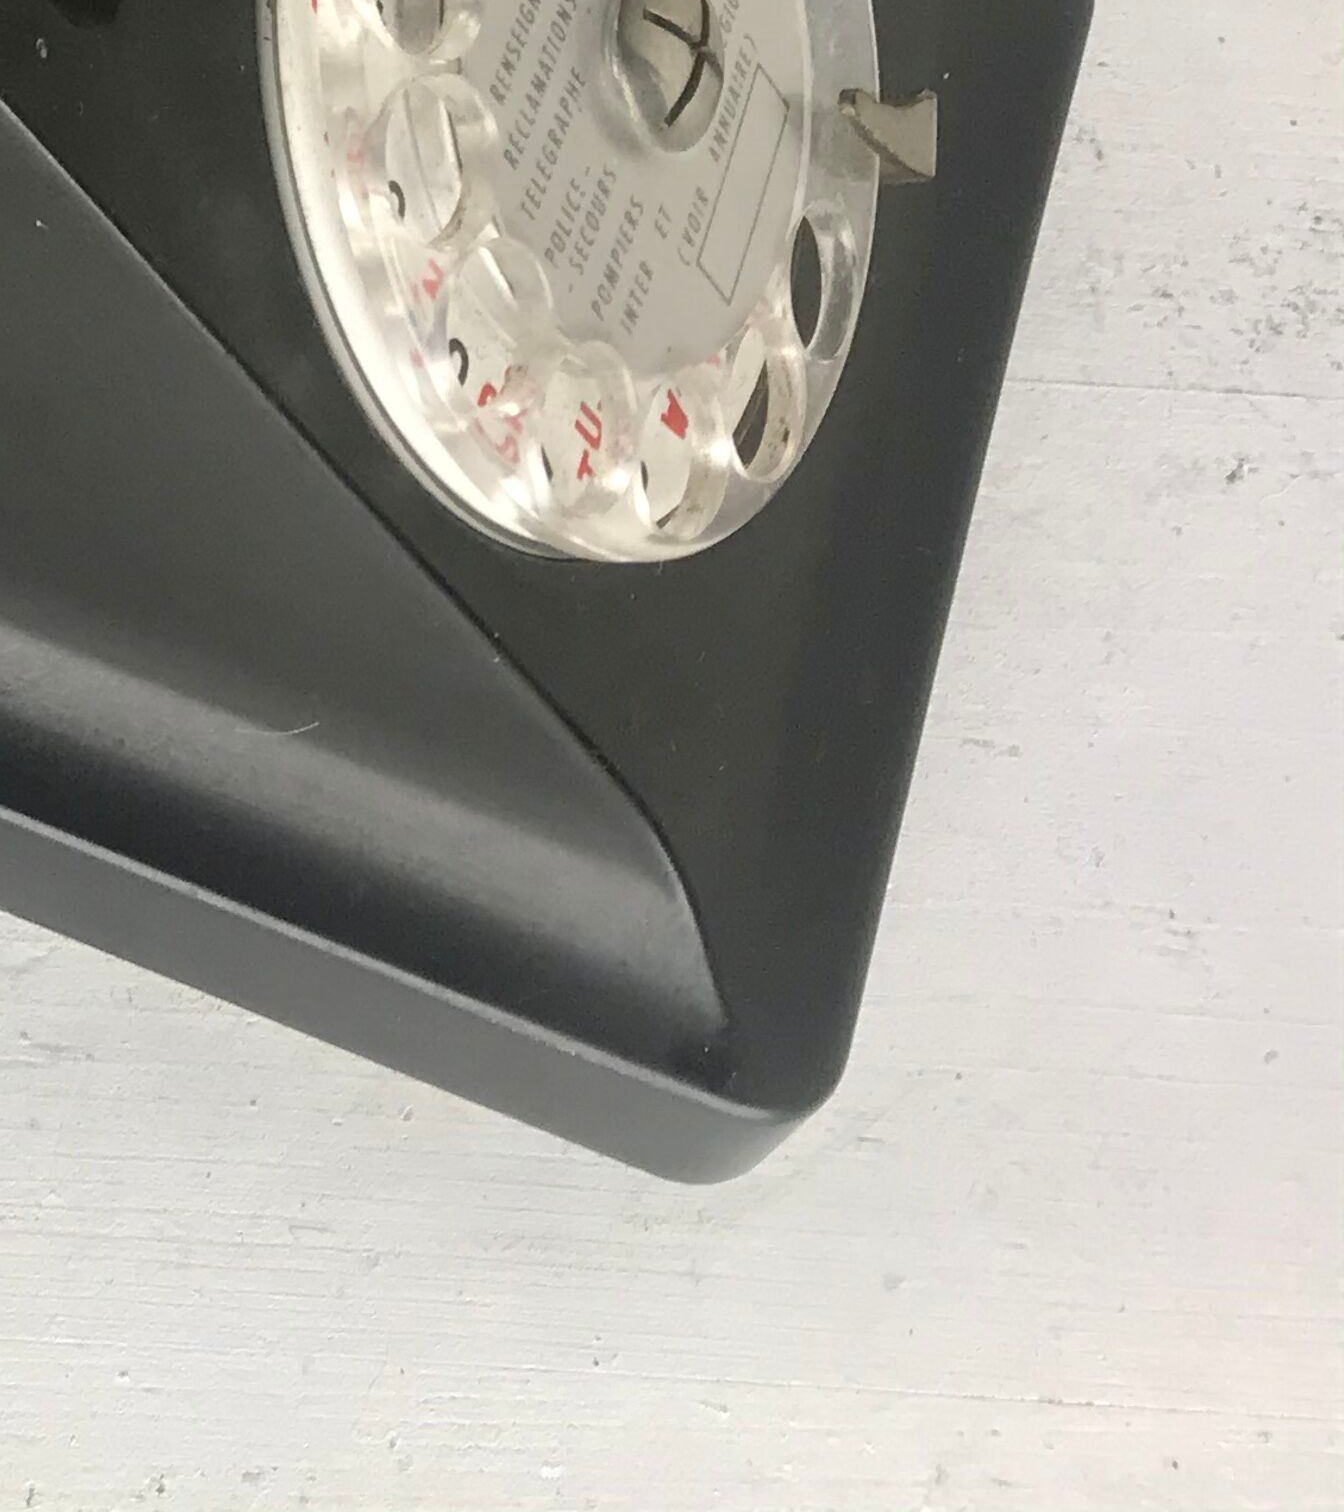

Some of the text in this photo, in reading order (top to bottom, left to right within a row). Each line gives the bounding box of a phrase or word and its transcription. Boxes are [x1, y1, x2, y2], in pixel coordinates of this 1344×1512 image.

[520, 66, 586, 221] TELEGRAPHE
[591, 193, 644, 322] POMPIERS
[620, 260, 654, 336] INTER
[654, 203, 672, 239] ET
